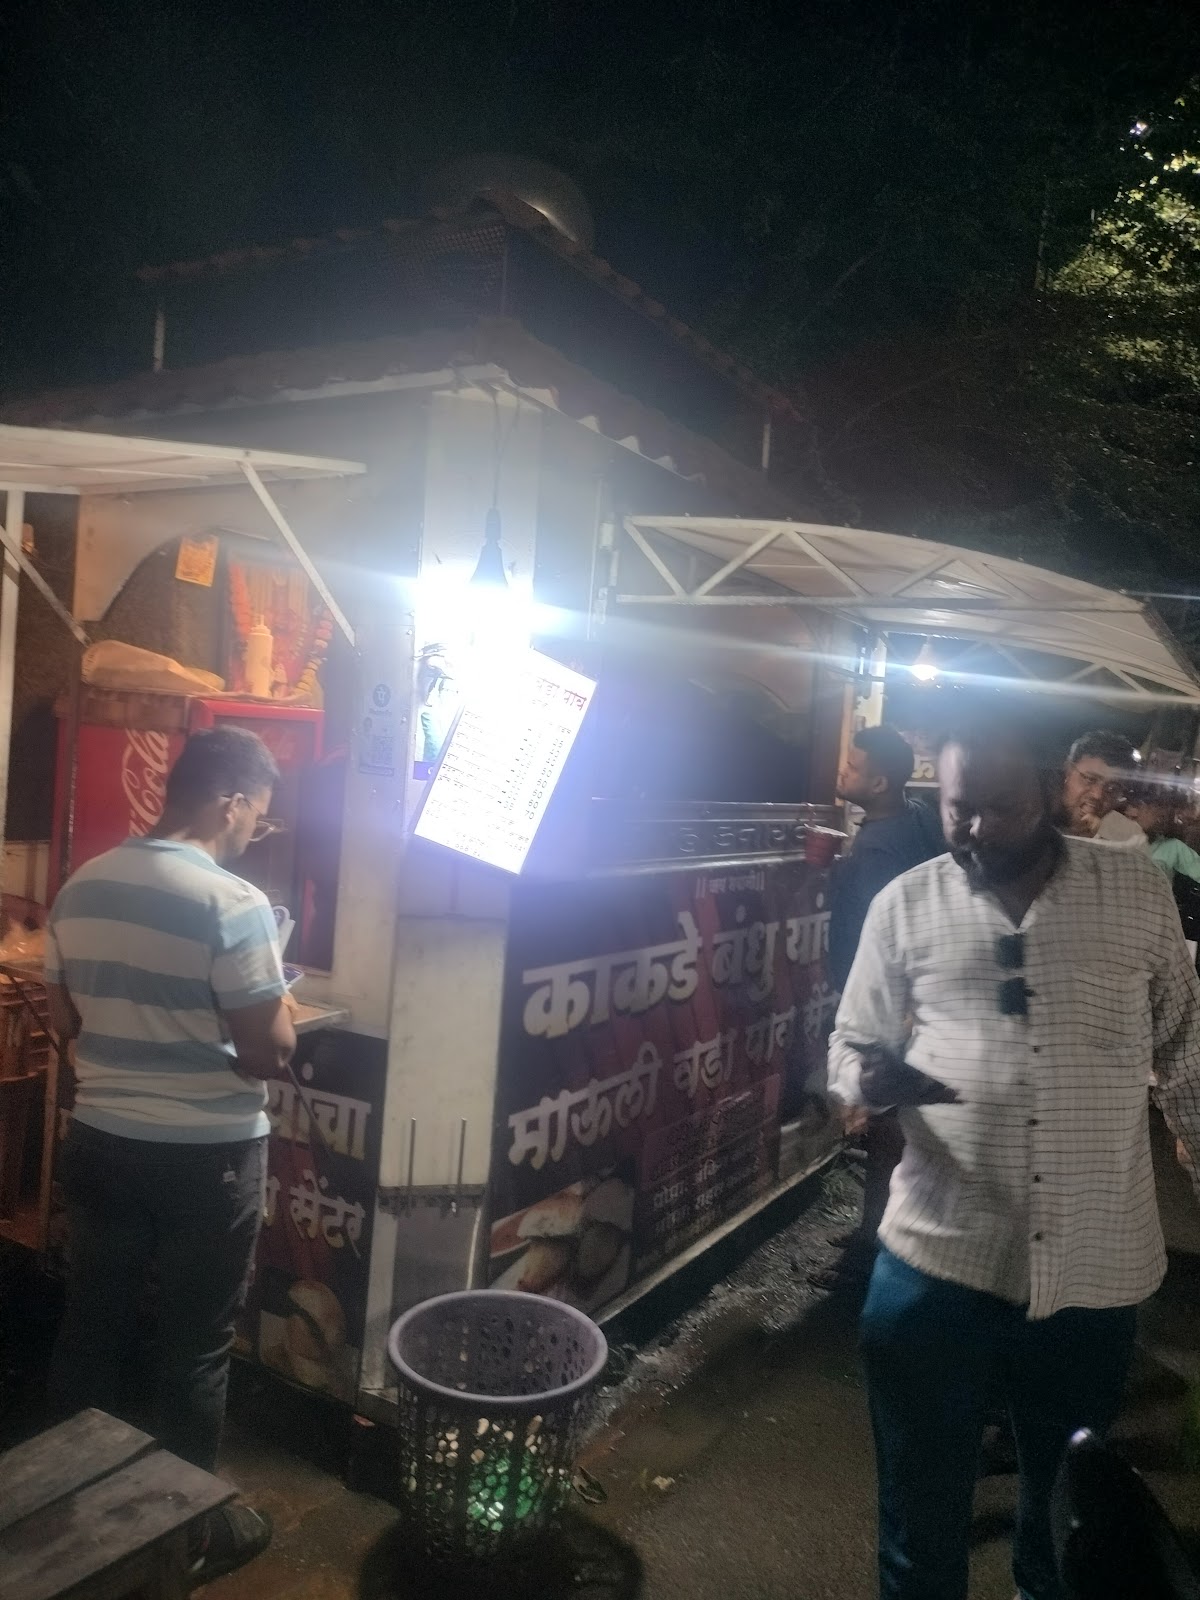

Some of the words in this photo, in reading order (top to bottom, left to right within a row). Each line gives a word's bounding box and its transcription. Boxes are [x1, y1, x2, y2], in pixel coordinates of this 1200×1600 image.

[563, 689, 588, 711] पाव
[524, 809, 535, 820] 70
[521, 910, 705, 1040] काकडे
[711, 903, 780, 1001] बंधु
[785, 892, 833, 965] यां
[507, 1041, 664, 1170] माऊली
[672, 1025, 737, 1099] वडा
[289, 1169, 367, 1259] सेंटर
